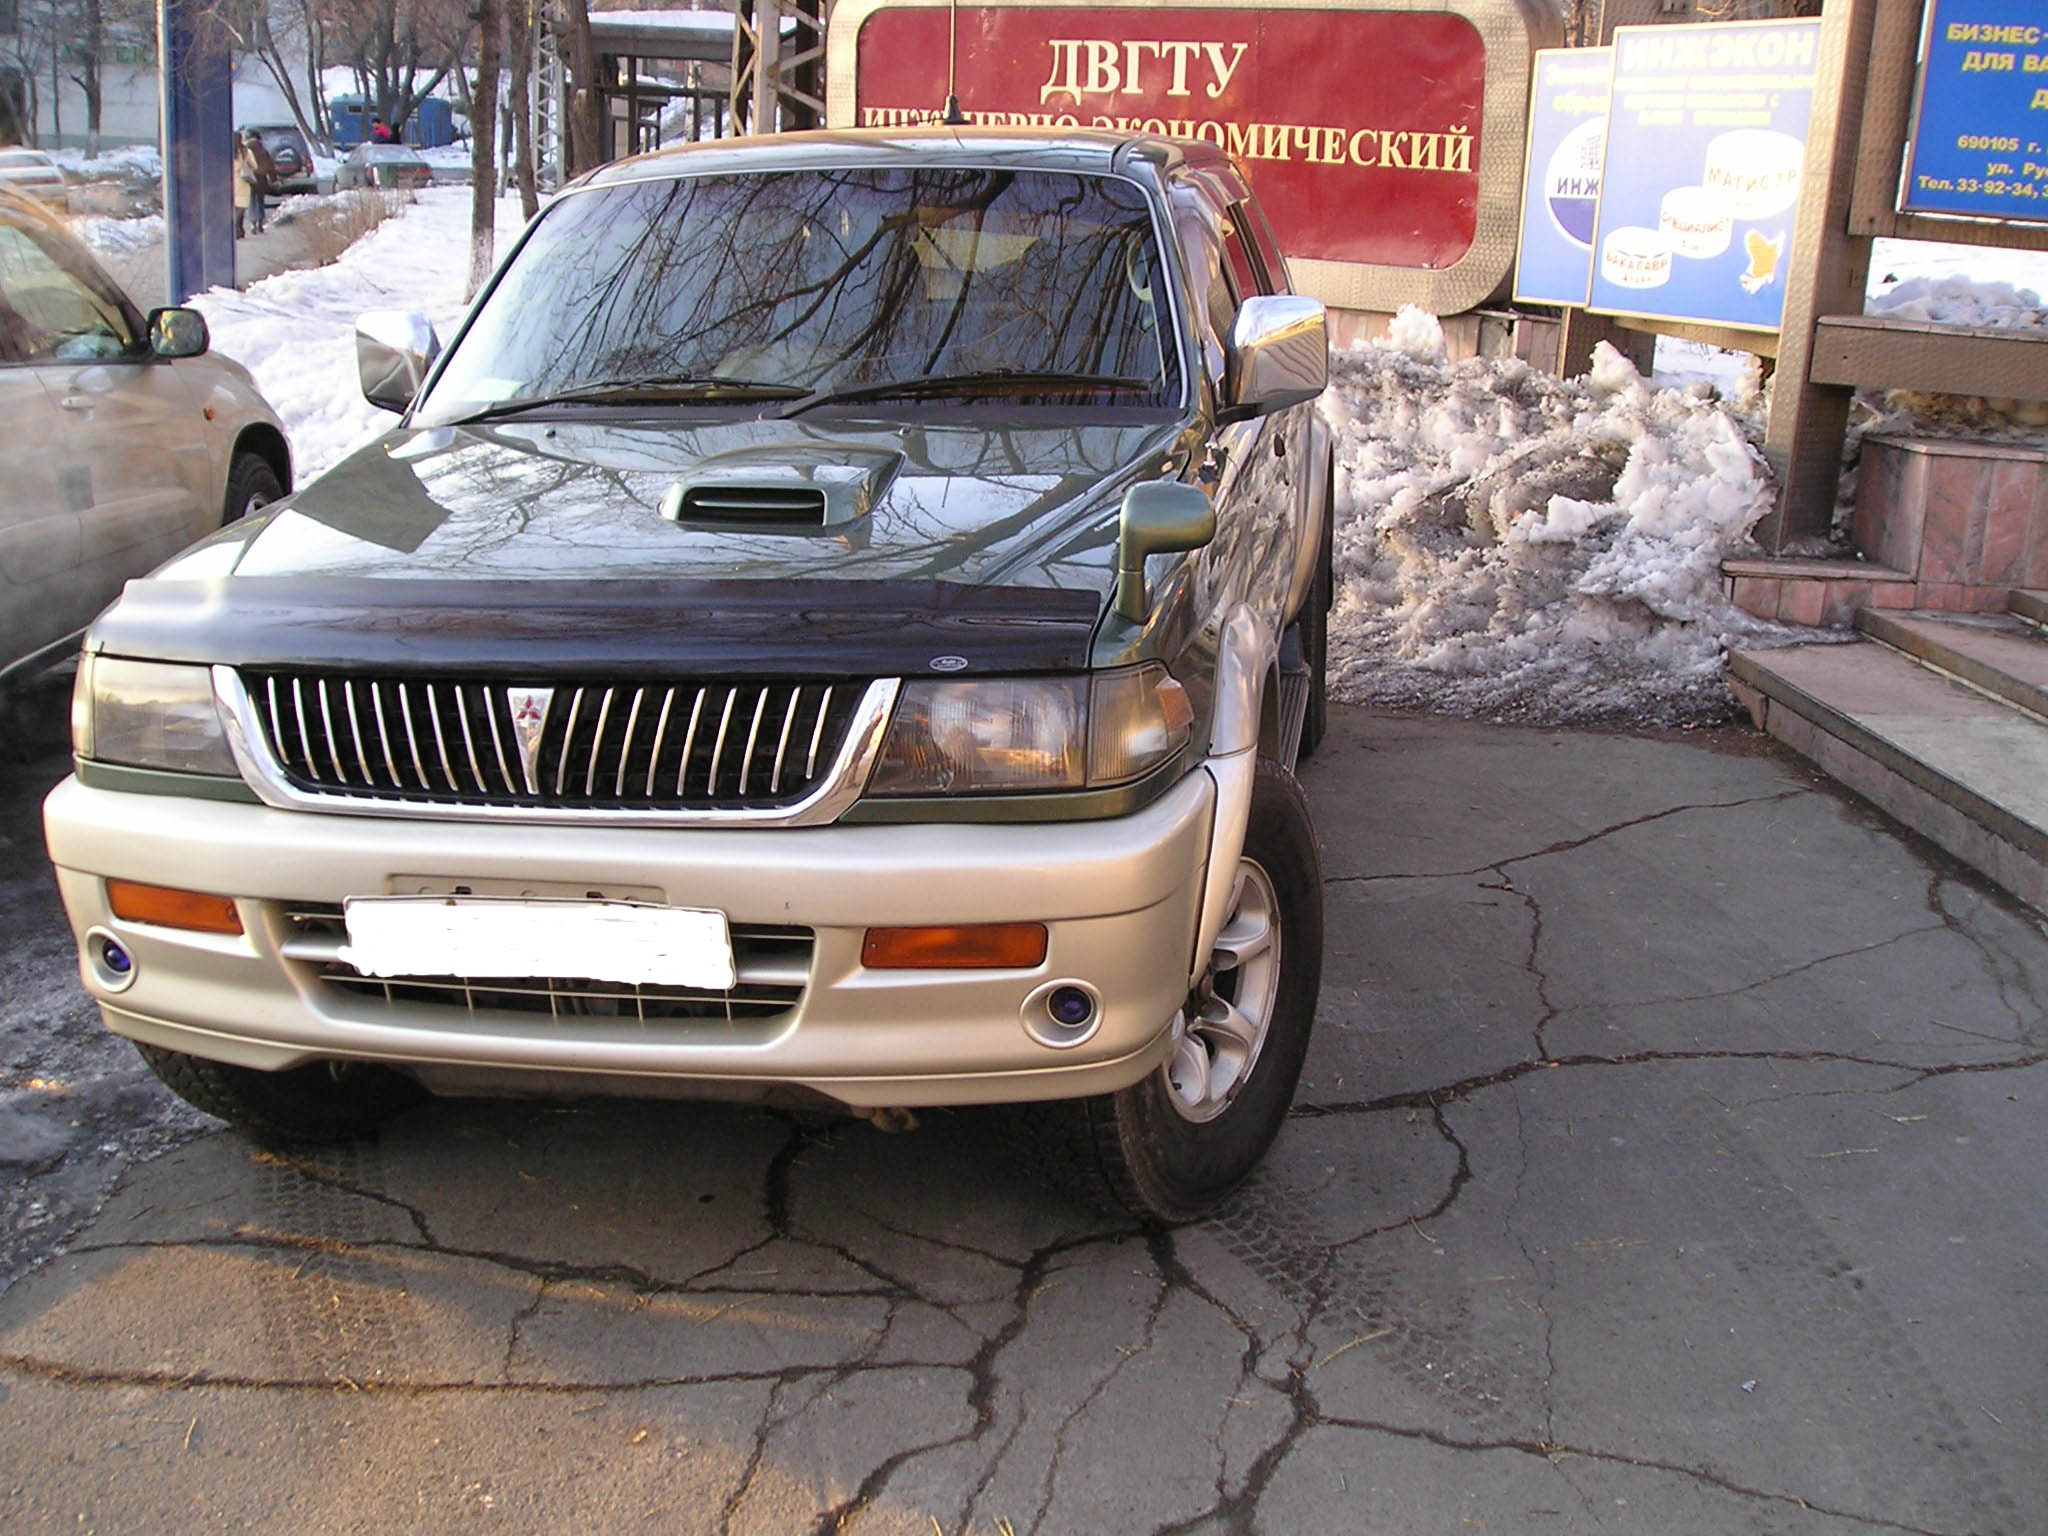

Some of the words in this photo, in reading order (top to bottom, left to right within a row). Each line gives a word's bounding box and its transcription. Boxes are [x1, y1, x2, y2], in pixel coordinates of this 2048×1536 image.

[60, 43, 157, 64] АТЕК
[1622, 31, 1815, 72] ИНЖЭКОН
[1963, 52, 2014, 72] ДЛЯ
[1040, 39, 1248, 105] ДВГТУ
[863, 107, 1474, 172] ИНЖОНОМИЧЕСКИЙ
[1958, 135, 2019, 151] 690105
[1708, 166, 1797, 193] МАГИСТР
[1987, 162, 2014, 176] ул.
[2023, 162, 2048, 180] Ру
[1918, 175, 1954, 190] Тел.
